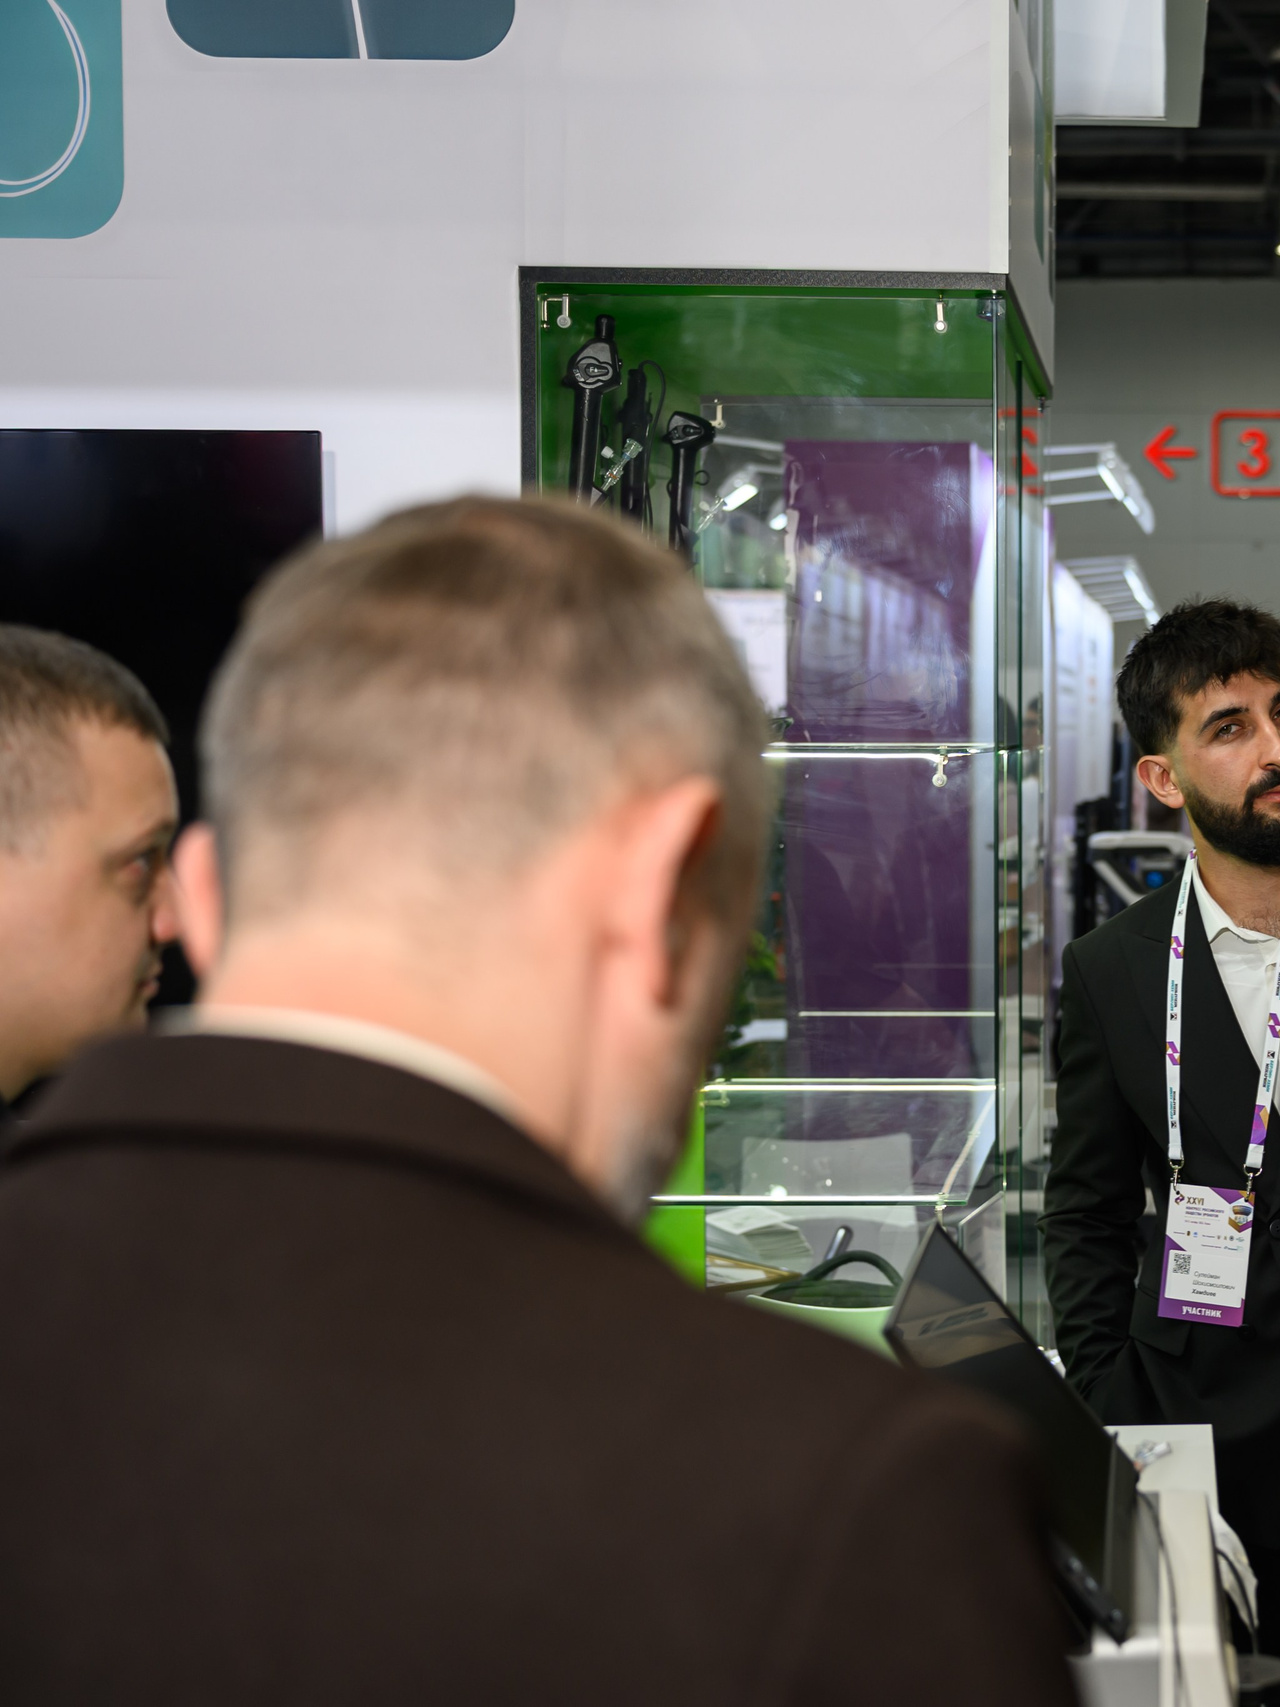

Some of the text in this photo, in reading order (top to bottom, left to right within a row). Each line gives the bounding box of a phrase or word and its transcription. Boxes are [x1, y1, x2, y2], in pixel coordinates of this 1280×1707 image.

[1236, 428, 1271, 478] 3
[1186, 1196, 1205, 1205] XXVI
[1194, 1271, 1220, 1279] Сулейман
[1182, 1306, 1222, 1317] УЧАСТНИК
